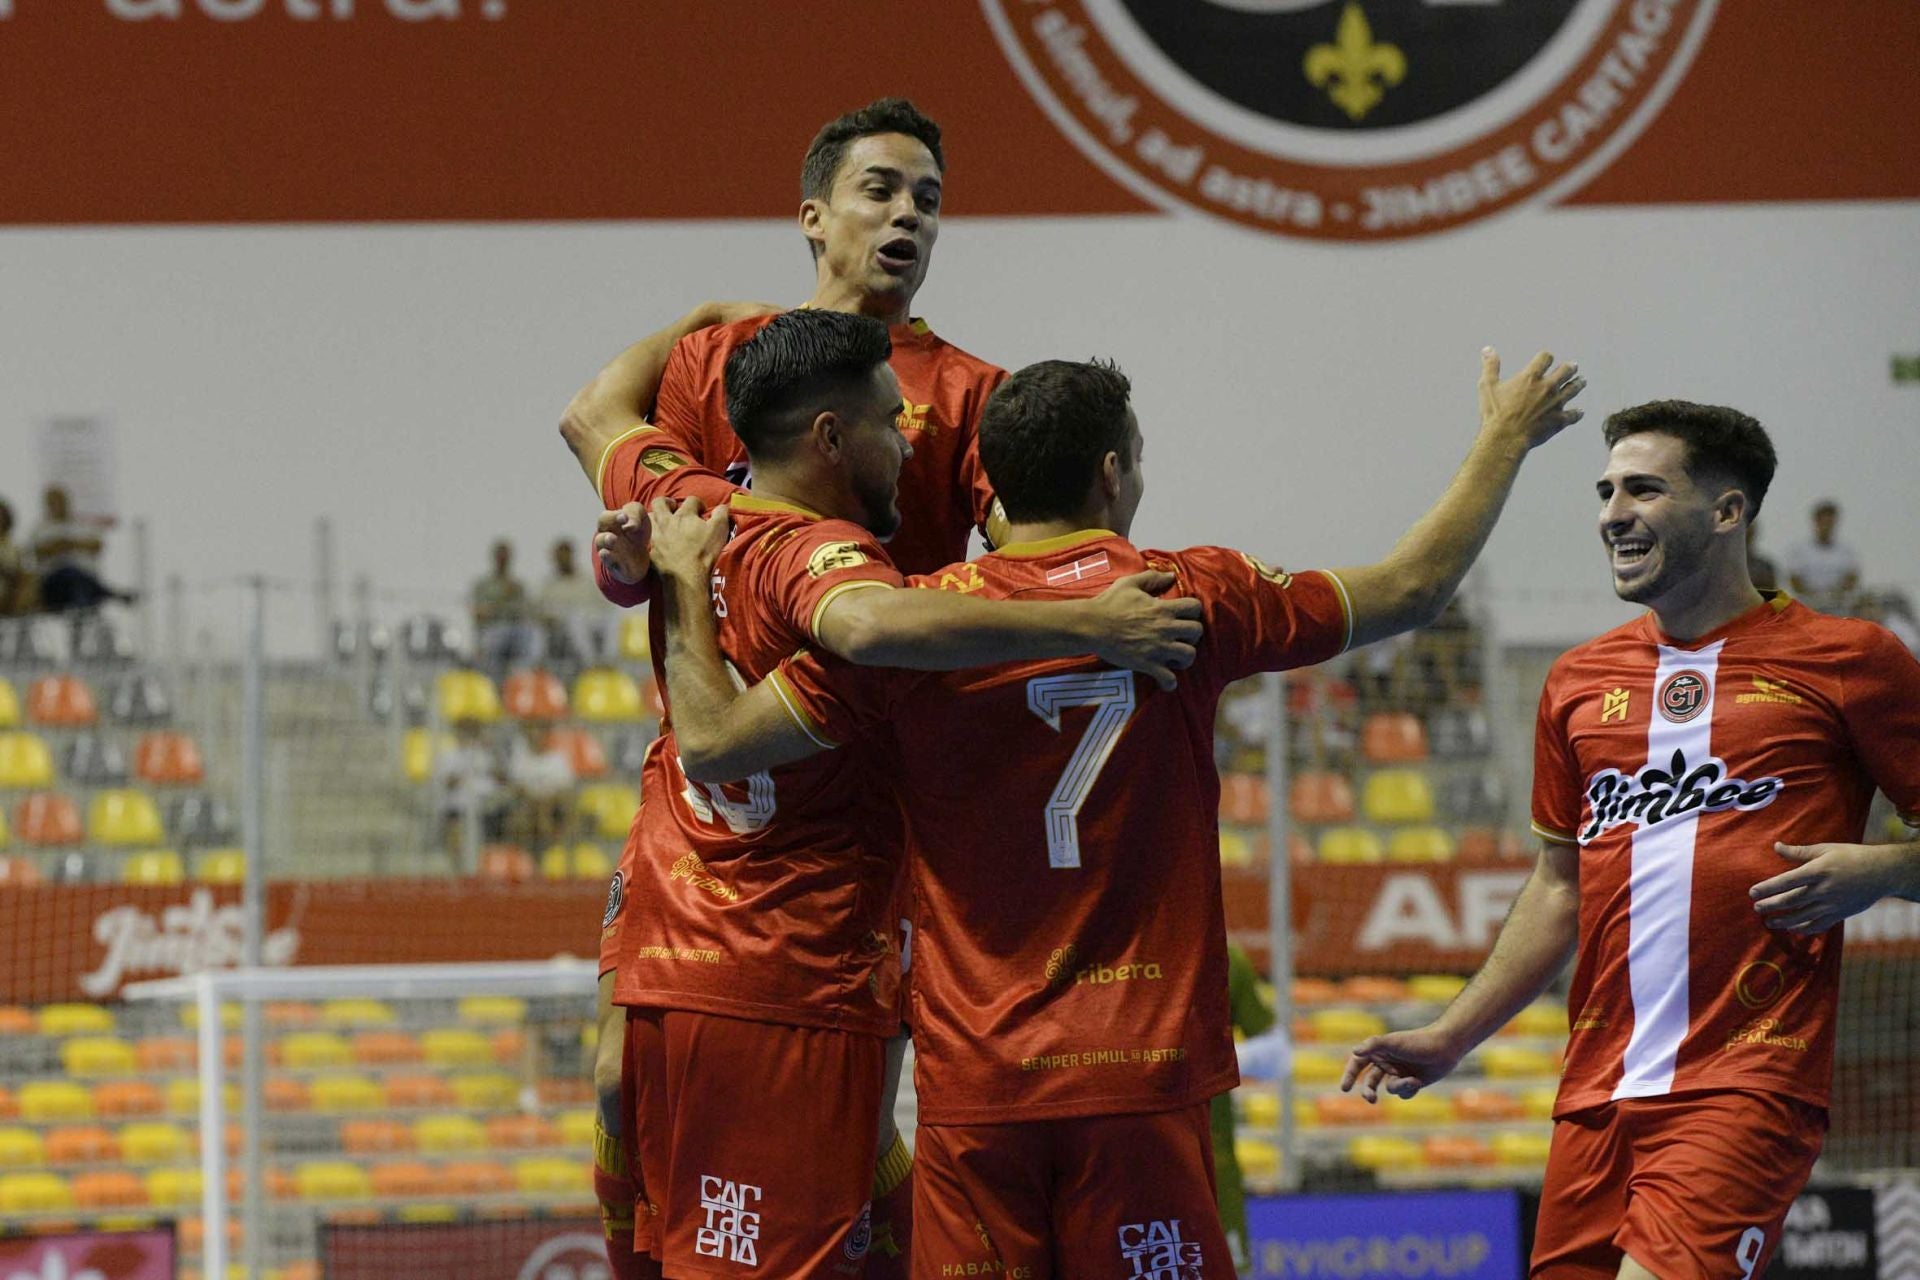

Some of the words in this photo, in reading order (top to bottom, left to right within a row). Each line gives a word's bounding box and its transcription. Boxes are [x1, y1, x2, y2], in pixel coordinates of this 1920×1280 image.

[1026, 669, 1136, 869] 7
[1582, 747, 1780, 842] Jimbee
[1073, 961, 1162, 986] ribera
[1021, 1055, 1079, 1071] SEMPER
[1082, 1051, 1129, 1065] SIMUL
